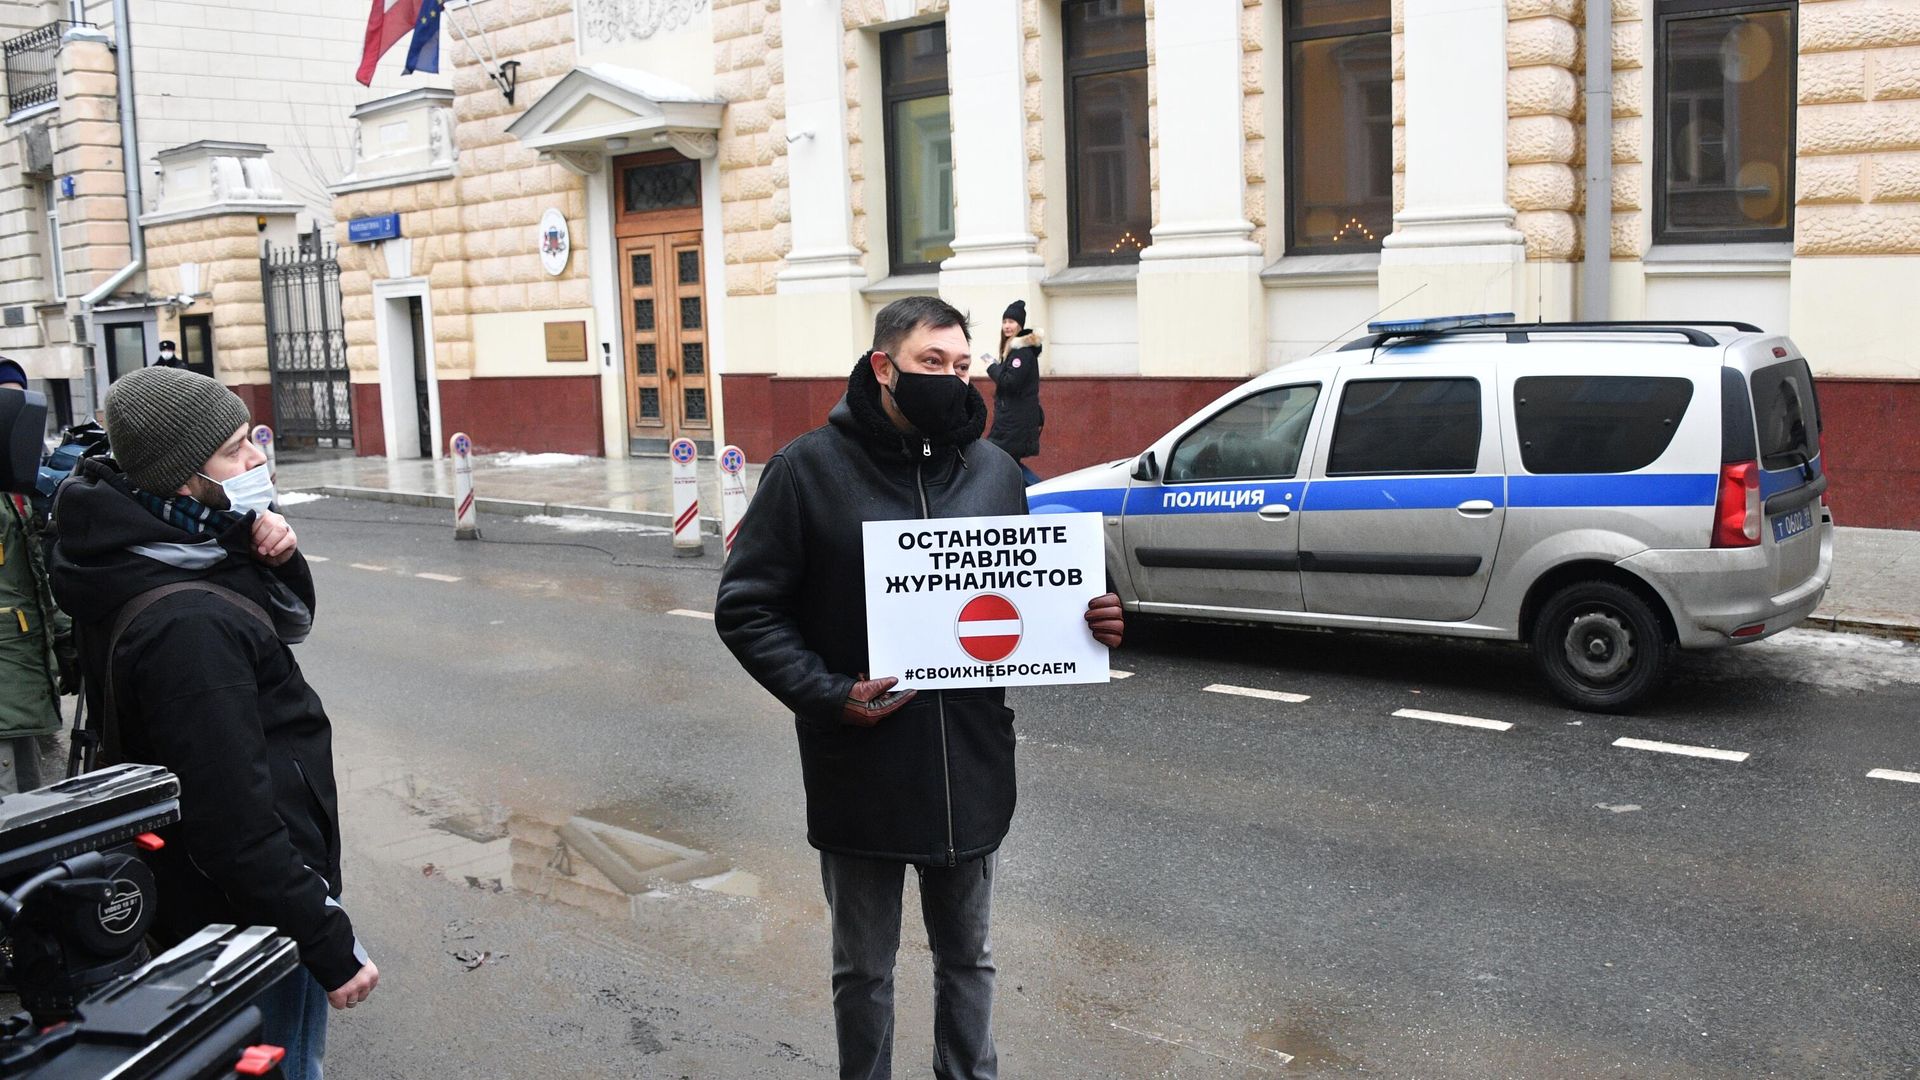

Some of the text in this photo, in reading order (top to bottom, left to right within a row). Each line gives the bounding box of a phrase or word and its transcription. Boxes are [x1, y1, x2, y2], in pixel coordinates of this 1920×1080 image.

[1162, 489, 1265, 508] ПОЛИЦИЯ
[898, 526, 1067, 550] ОСТАНОВИТЕ
[1777, 522, 1783, 537] Т
[929, 548, 1037, 570] ТРАВЛЮ
[885, 568, 1083, 593] ЖУРНАЛИСТОВ
[904, 662, 1076, 681] #СВОИХНЕБРОСАЕМ
[104, 903, 121, 914] VIDEO
